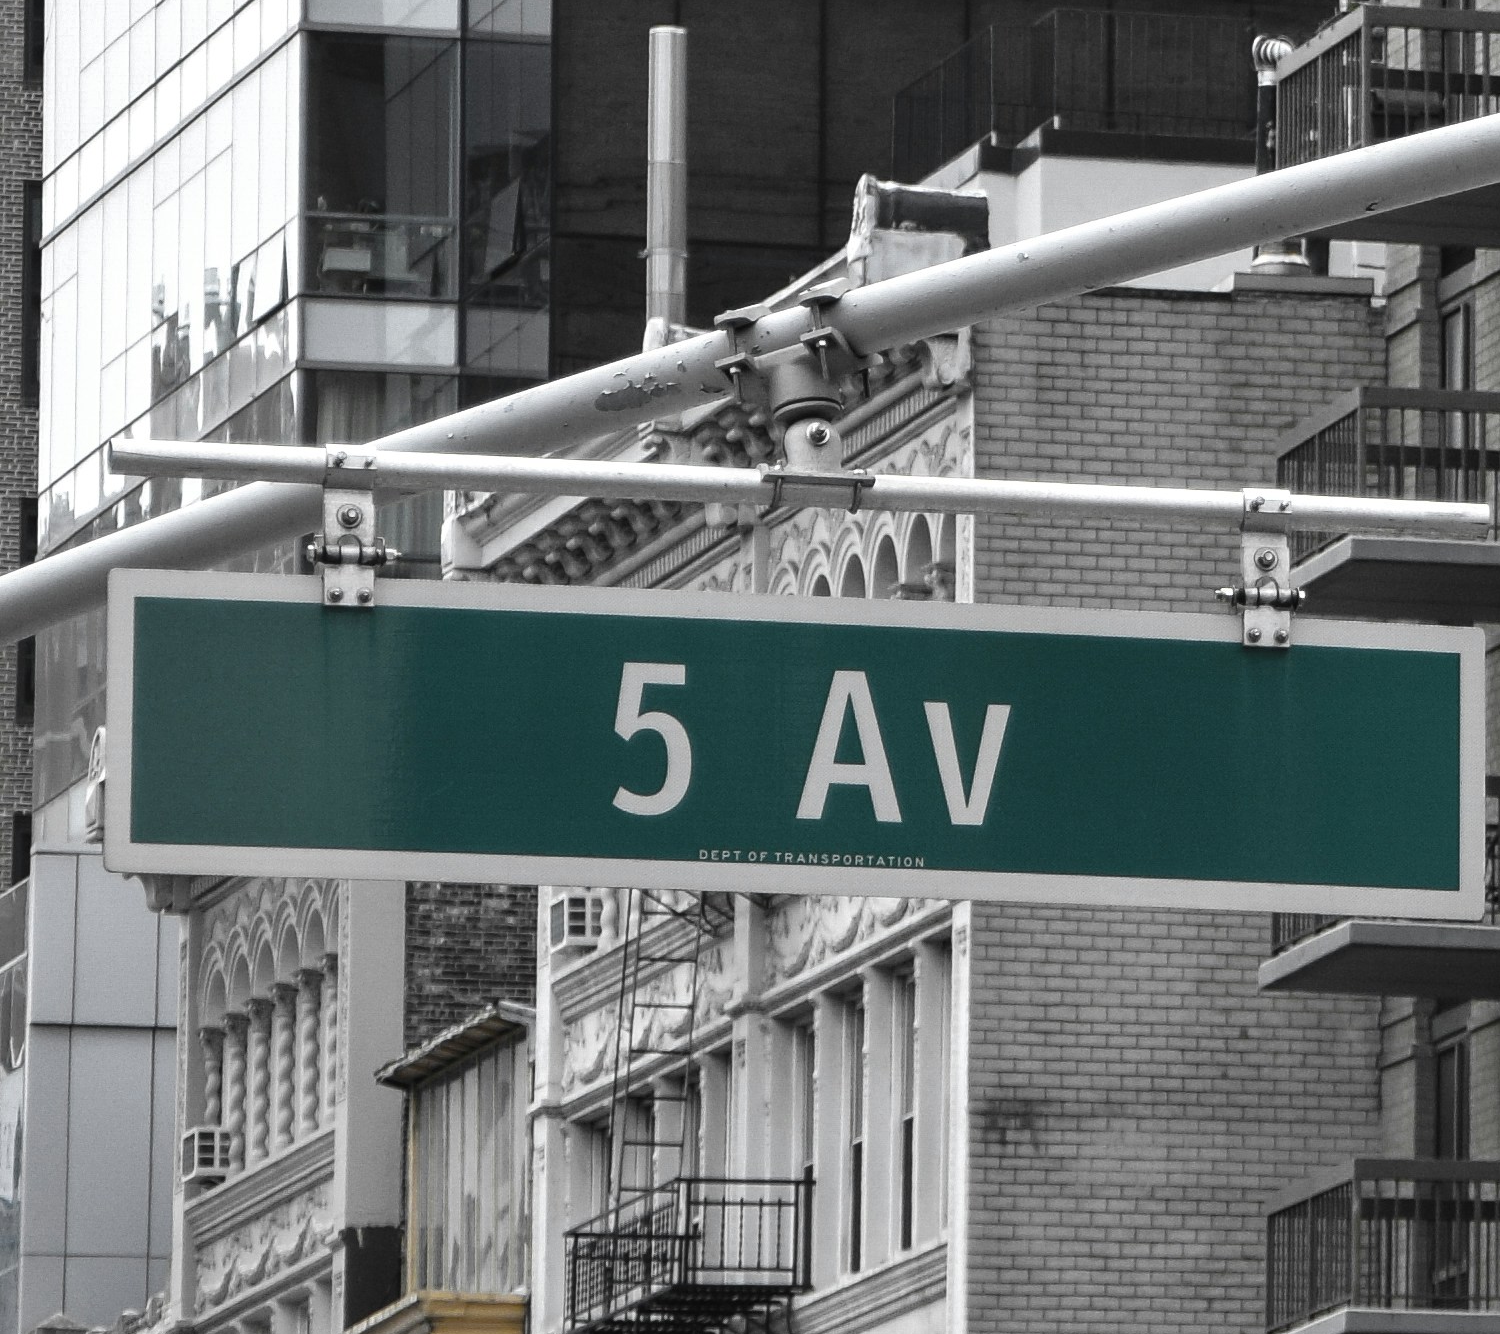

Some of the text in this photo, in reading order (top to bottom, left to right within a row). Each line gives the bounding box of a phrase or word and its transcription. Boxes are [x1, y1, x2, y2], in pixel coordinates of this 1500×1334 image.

[612, 662, 1011, 825] 5 Av
[699, 849, 925, 867] DEPT OF TRANSPORTATION
